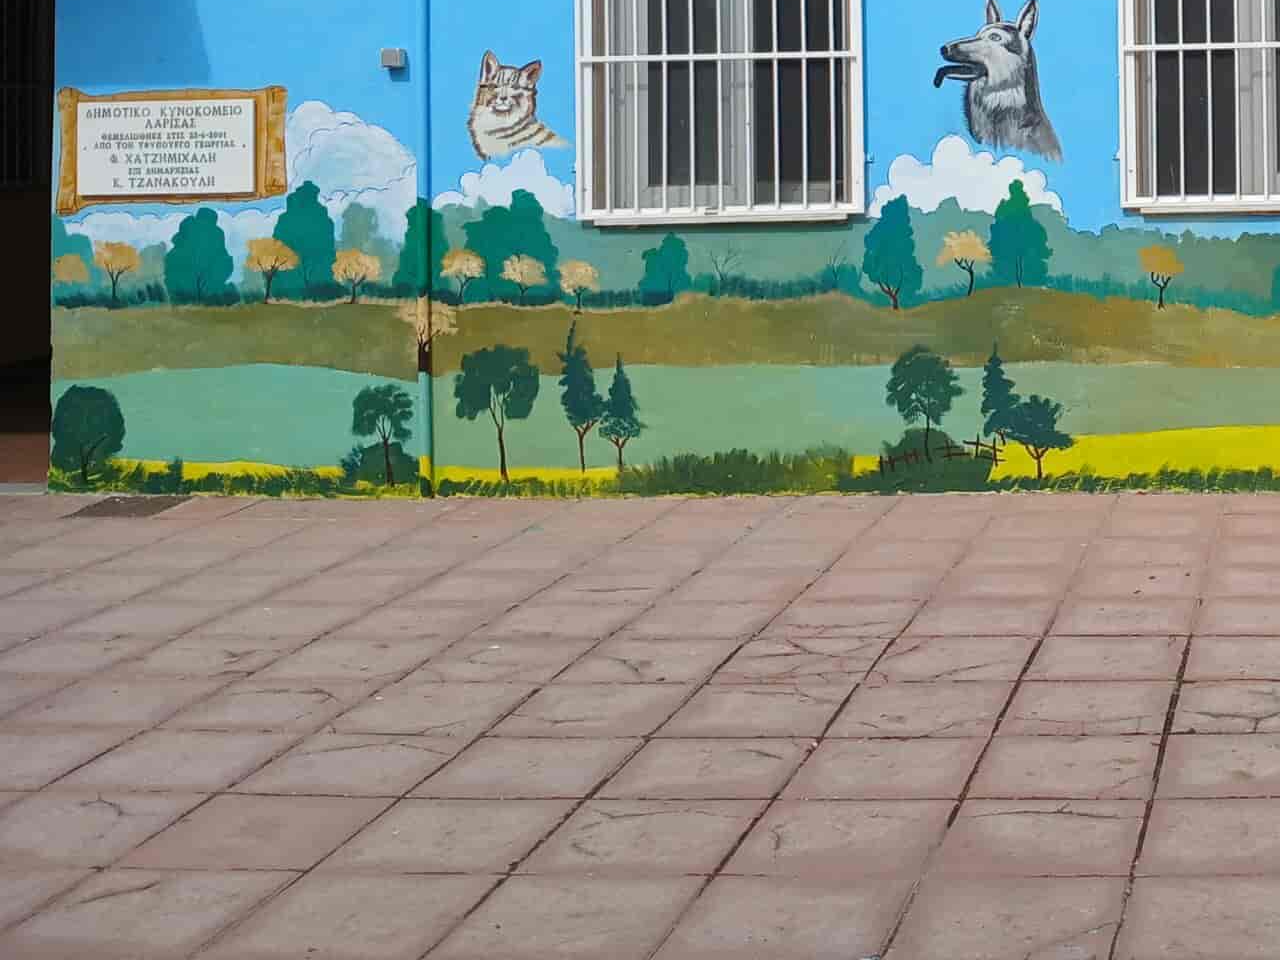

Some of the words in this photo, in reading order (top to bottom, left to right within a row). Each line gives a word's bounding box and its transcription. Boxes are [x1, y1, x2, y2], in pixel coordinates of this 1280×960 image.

[86, 107, 151, 118] ΔΗΜΟΤΙΚΟ
[160, 105, 243, 117] ΚΥΝΟΚΟΜΕΙΟ
[145, 118, 197, 129] ΛΑΡΙΣΑΣ
[125, 152, 217, 164] ΧΑΤΖΗΜΙΧΑΛΗ
[128, 176, 216, 188] ΤΖΑΝΑΚΟΥΛΗ
